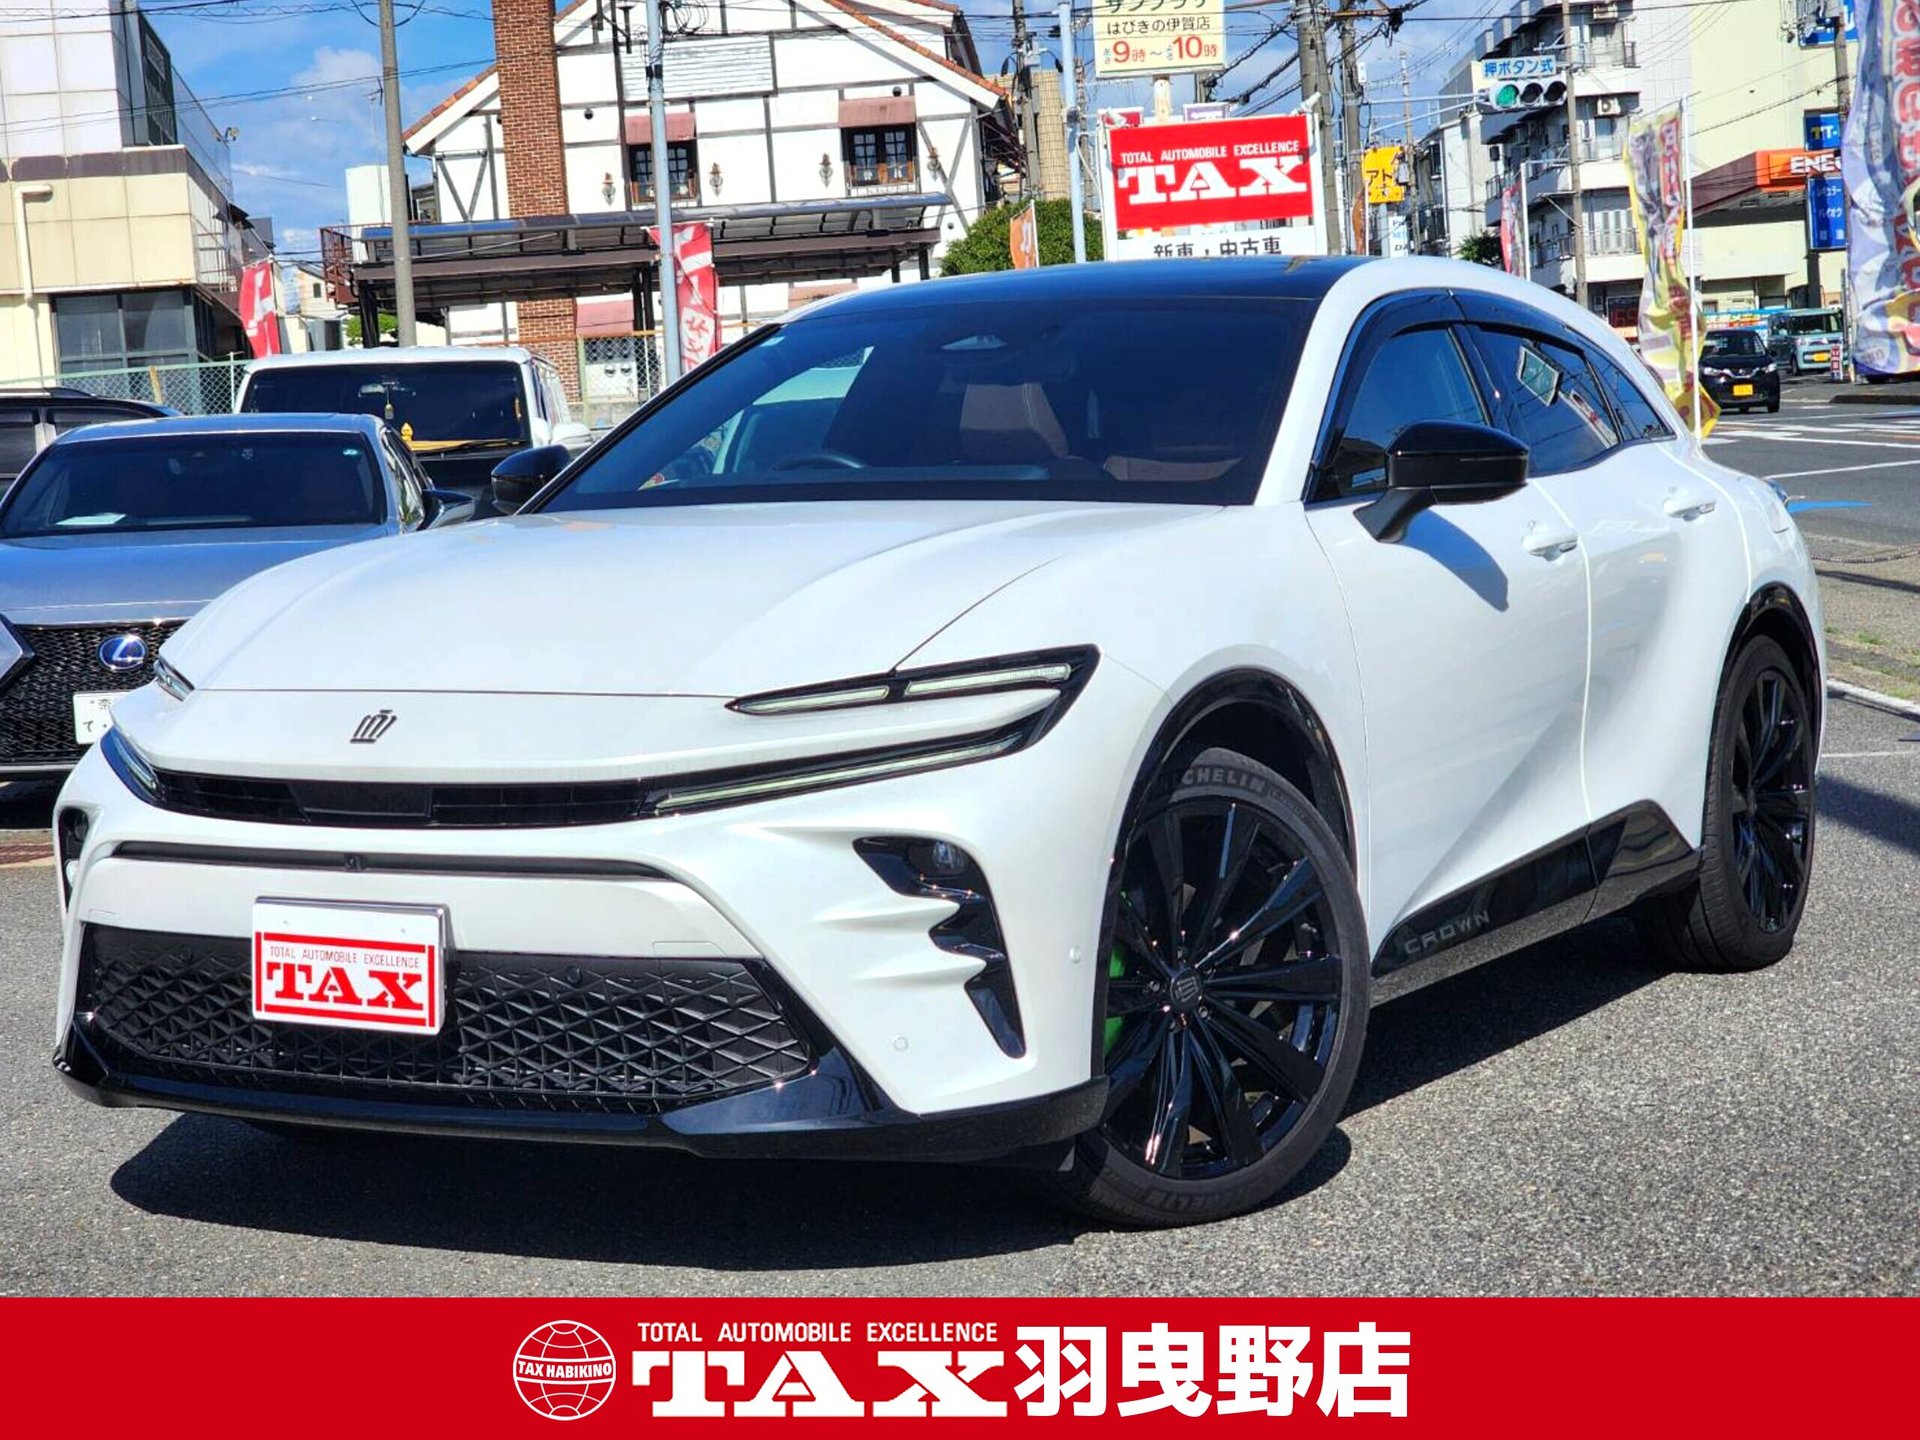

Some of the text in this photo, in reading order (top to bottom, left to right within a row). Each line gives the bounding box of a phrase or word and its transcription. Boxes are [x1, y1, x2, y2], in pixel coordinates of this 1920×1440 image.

[1107, 16, 1211, 35] はびきの伊賀店
[1484, 58, 1554, 77] 押ボタン式
[1120, 140, 1300, 165] TOTAL AUTOMOBILE EXCELLENCE
[1117, 155, 1308, 205] TAX
[1404, 909, 1491, 955] CROWN
[269, 945, 420, 969] TOTAL AUTOMOBILE EXCELLENCE
[266, 961, 424, 1011] TAX
